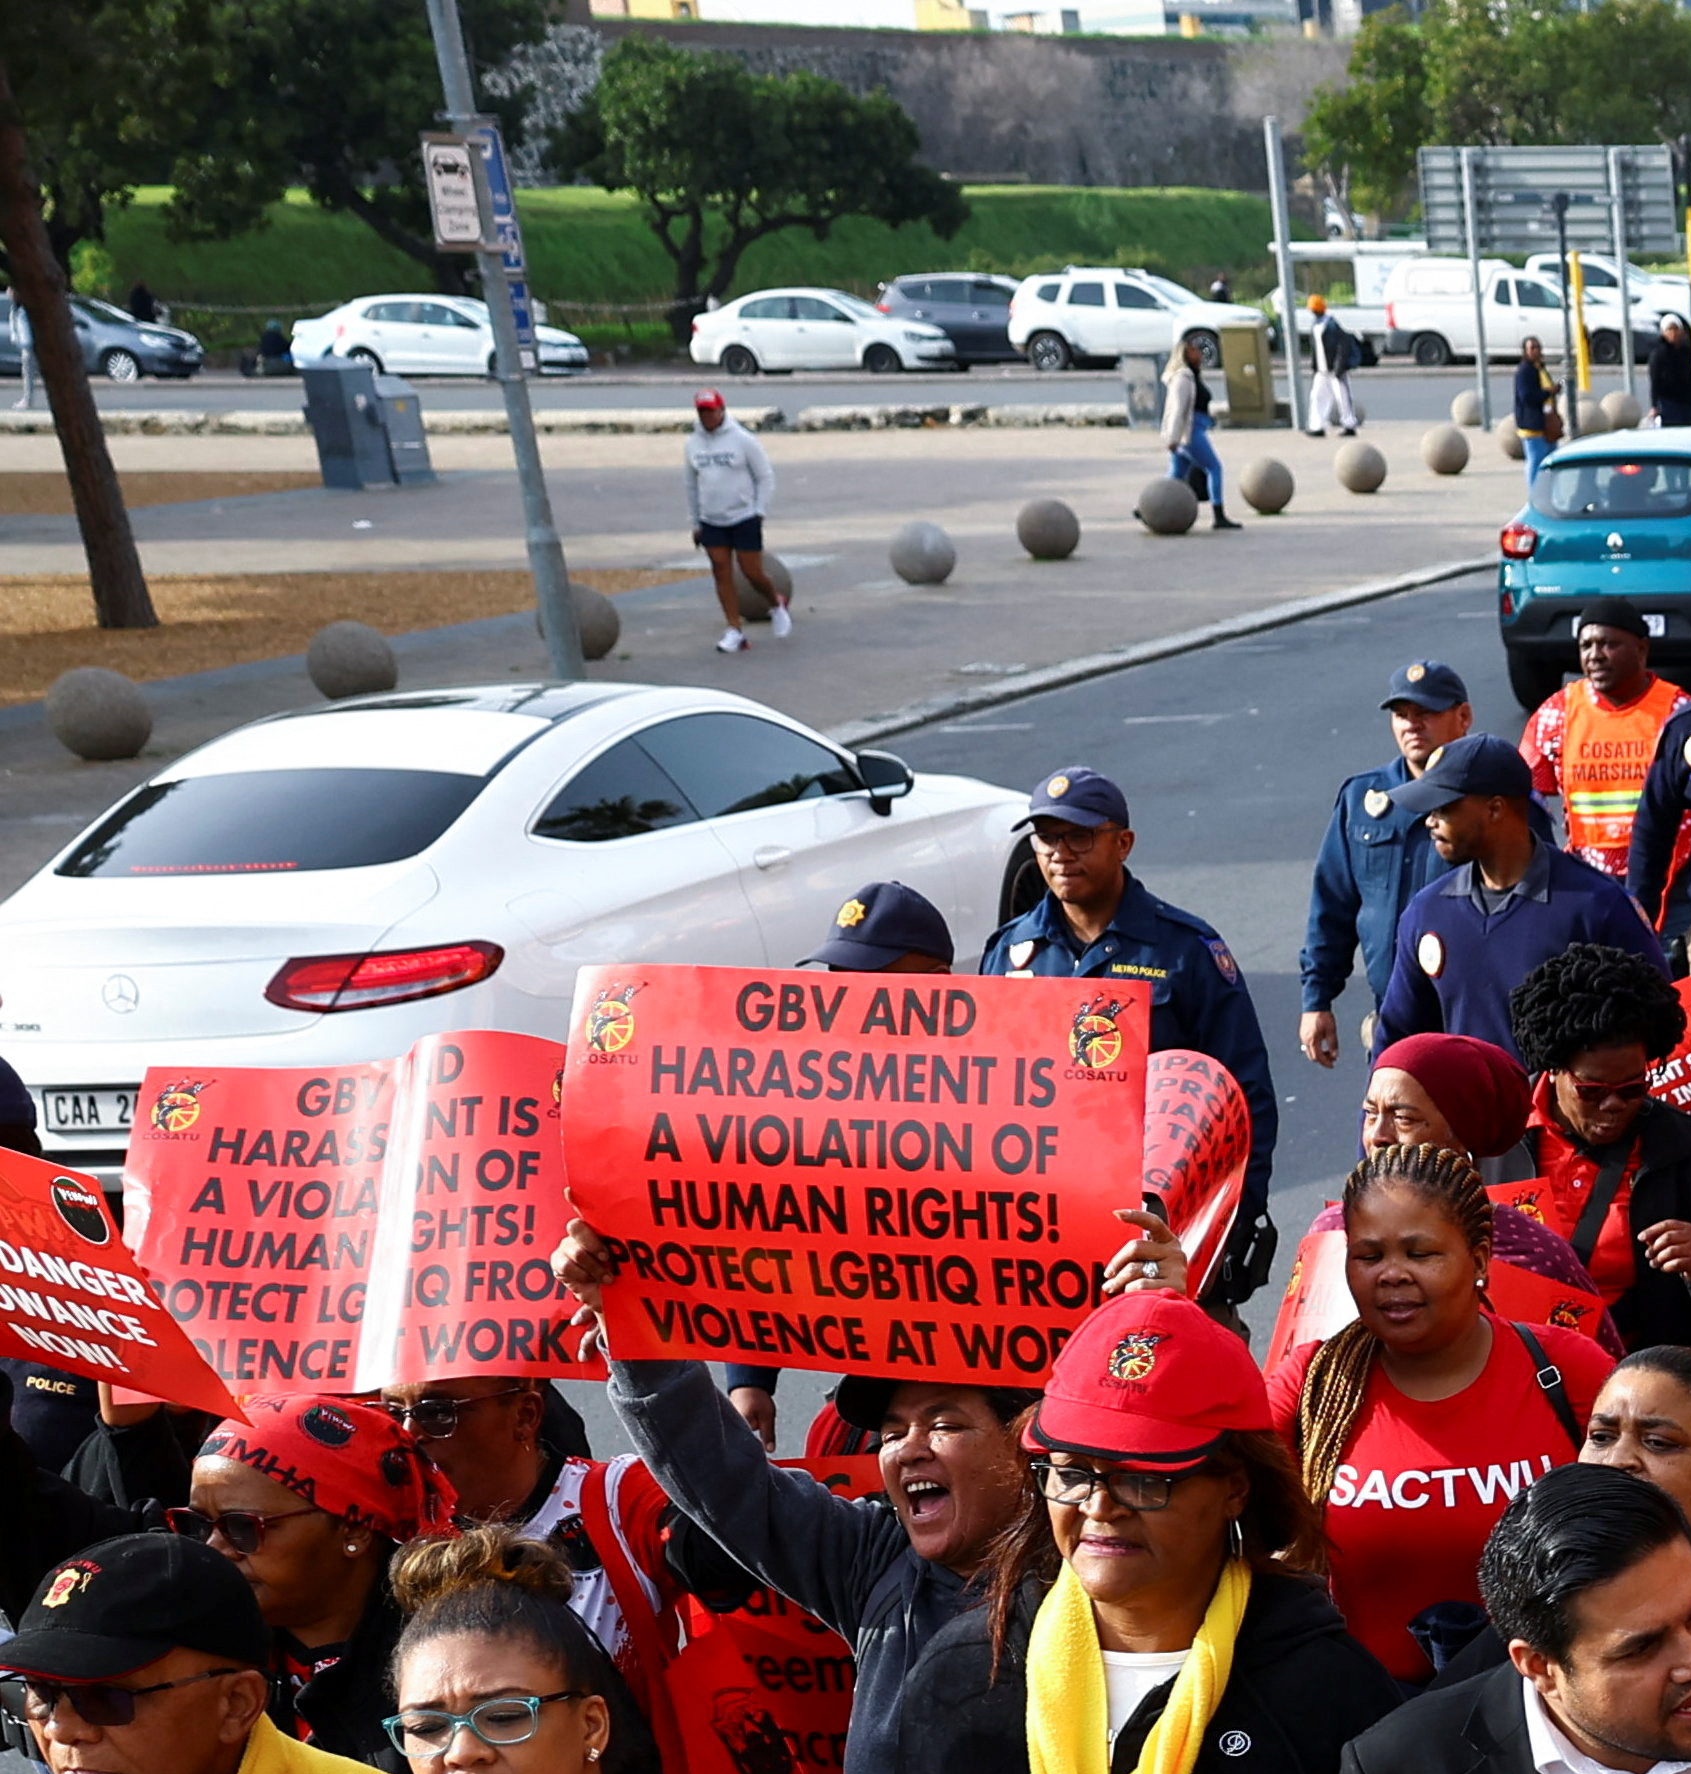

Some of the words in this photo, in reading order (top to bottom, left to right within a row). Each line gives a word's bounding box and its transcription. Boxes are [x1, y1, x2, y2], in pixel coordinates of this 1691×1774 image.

[1579, 740, 1645, 760] COSATU
[1110, 962, 1139, 975] METRO
[1138, 966, 1168, 979] POLICE
[735, 981, 848, 1036] GBV
[860, 983, 977, 1038] AND
[296, 1076, 389, 1118] GBV
[650, 1044, 998, 1107] HARASSMENT
[1013, 1056, 1057, 1109] IS
[1063, 1069, 1129, 1083] COSATU
[54, 1102, 102, 1128] CAA
[498, 1096, 539, 1137] IS
[643, 1112, 682, 1163] A
[694, 1113, 974, 1175] VIOLATION
[991, 1122, 1059, 1175] OF
[189, 1176, 226, 1215] A
[475, 1150, 541, 1191] OF
[647, 1178, 846, 1237] HUMAN
[866, 1187, 1061, 1244] RIGHTS!
[180, 1225, 368, 1269] HUMAN
[602, 1235, 794, 1295] PROTECT
[813, 1252, 979, 1310] LGBTIQ
[0, 1242, 160, 1312] DANGER
[7, 1320, 131, 1375] NOW!
[419, 1317, 573, 1364] WORK
[640, 1296, 872, 1364] VIOLENCE
[885, 1313, 938, 1367] AT
[26, 1376, 76, 1396] POLICE
